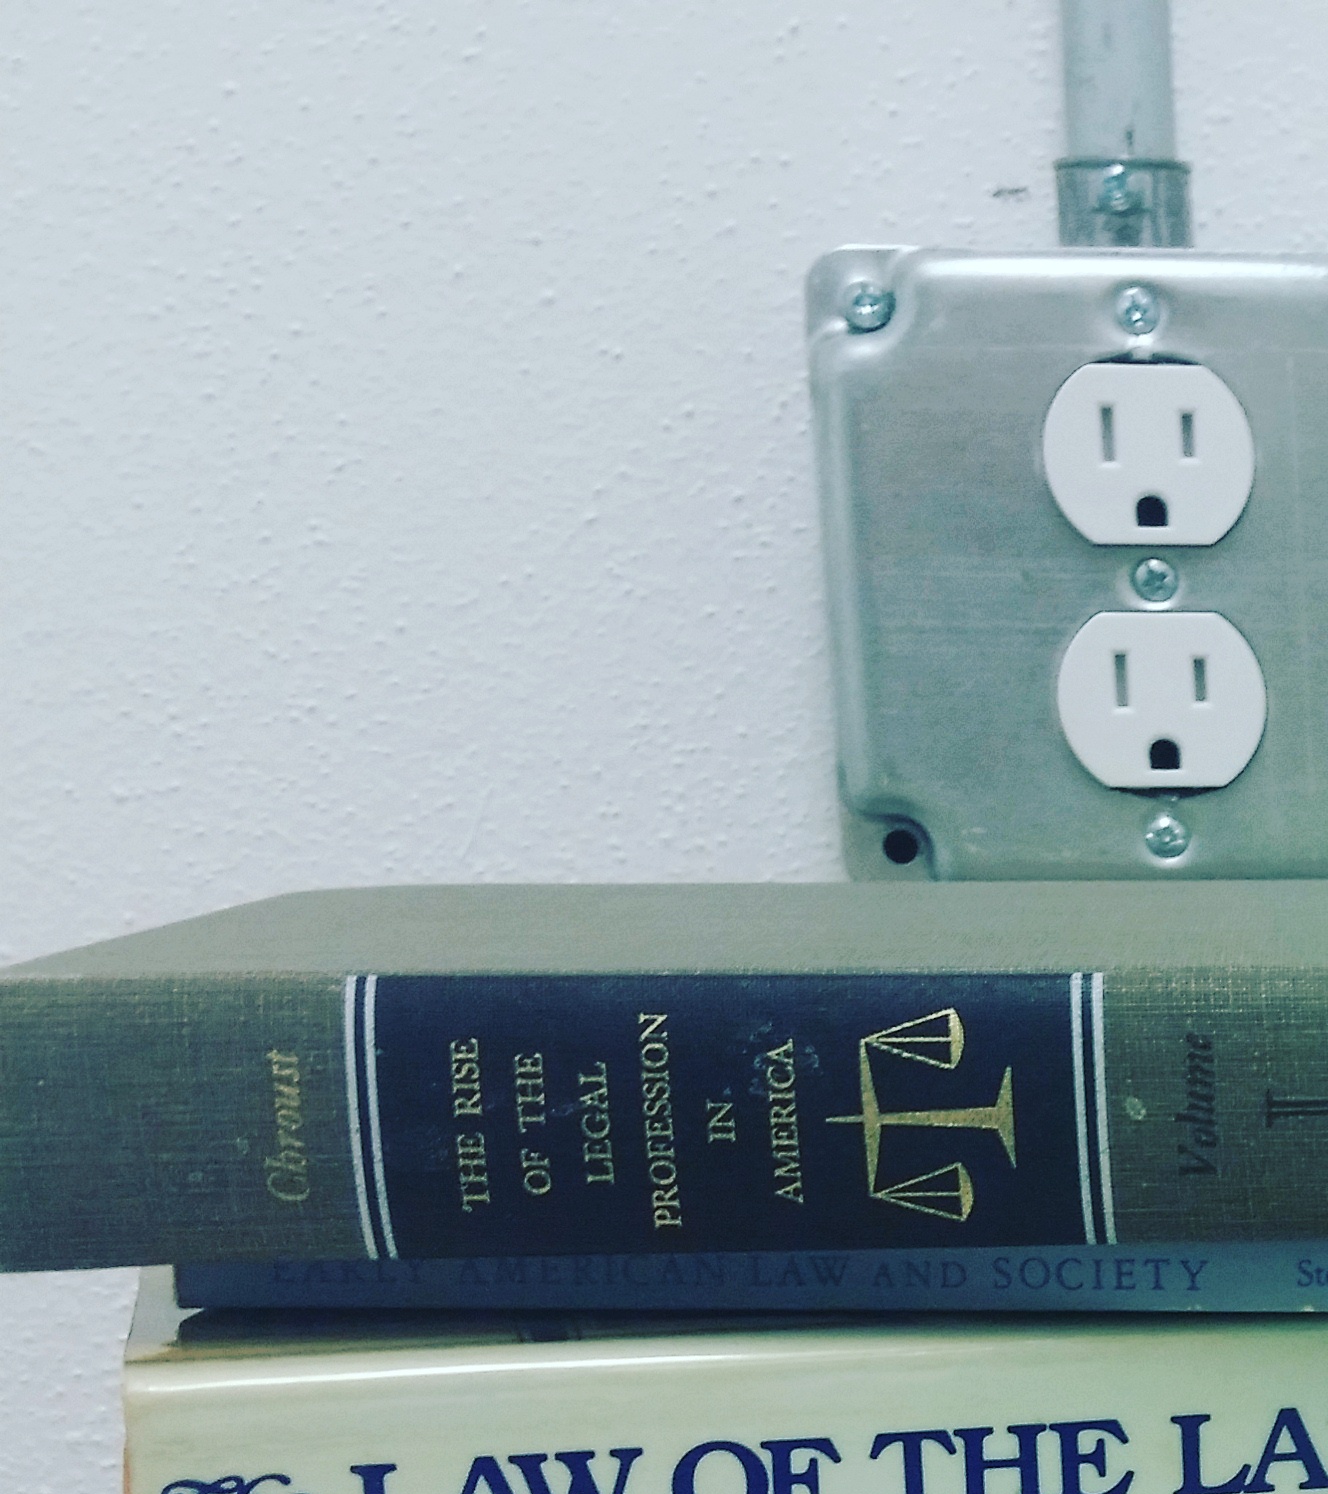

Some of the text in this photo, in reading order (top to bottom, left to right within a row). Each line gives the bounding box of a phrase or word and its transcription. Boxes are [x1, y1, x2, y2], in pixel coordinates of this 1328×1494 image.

[450, 1037, 490, 1213] THE RISE
[514, 1052, 550, 1196] OF THE
[578, 1061, 614, 1185] LEGAL
[638, 1012, 682, 1229] PROFESSION
[706, 1100, 735, 1143] IN
[765, 1037, 804, 1203] AMERICA
[1175, 1031, 1218, 1178] Volume
[459, 1254, 727, 1286] AMERICAN
[749, 1256, 849, 1288] LAW
[872, 1261, 967, 1288] AND
[993, 1257, 1209, 1291] SOCIETY
